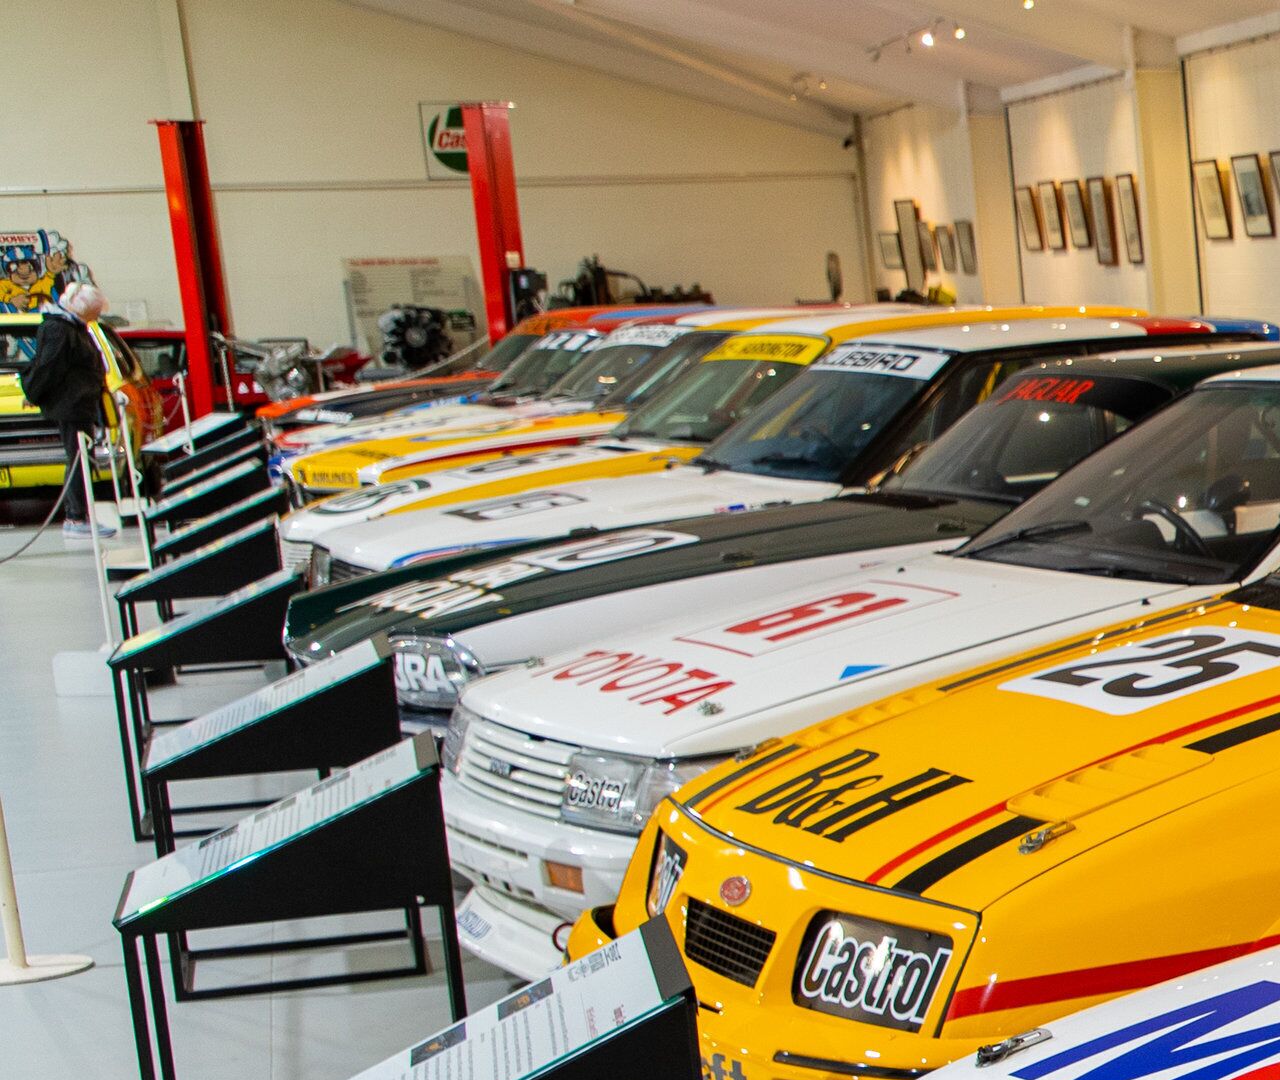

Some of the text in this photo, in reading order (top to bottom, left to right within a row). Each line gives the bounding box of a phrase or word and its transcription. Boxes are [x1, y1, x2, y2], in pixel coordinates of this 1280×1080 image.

[995, 376, 1095, 406] JAGUAR
[726, 590, 909, 642] 61
[531, 649, 736, 717] TOYOTA
[568, 768, 630, 811] Castrol
[734, 748, 975, 843] B&H
[801, 919, 954, 1025] Castrol
